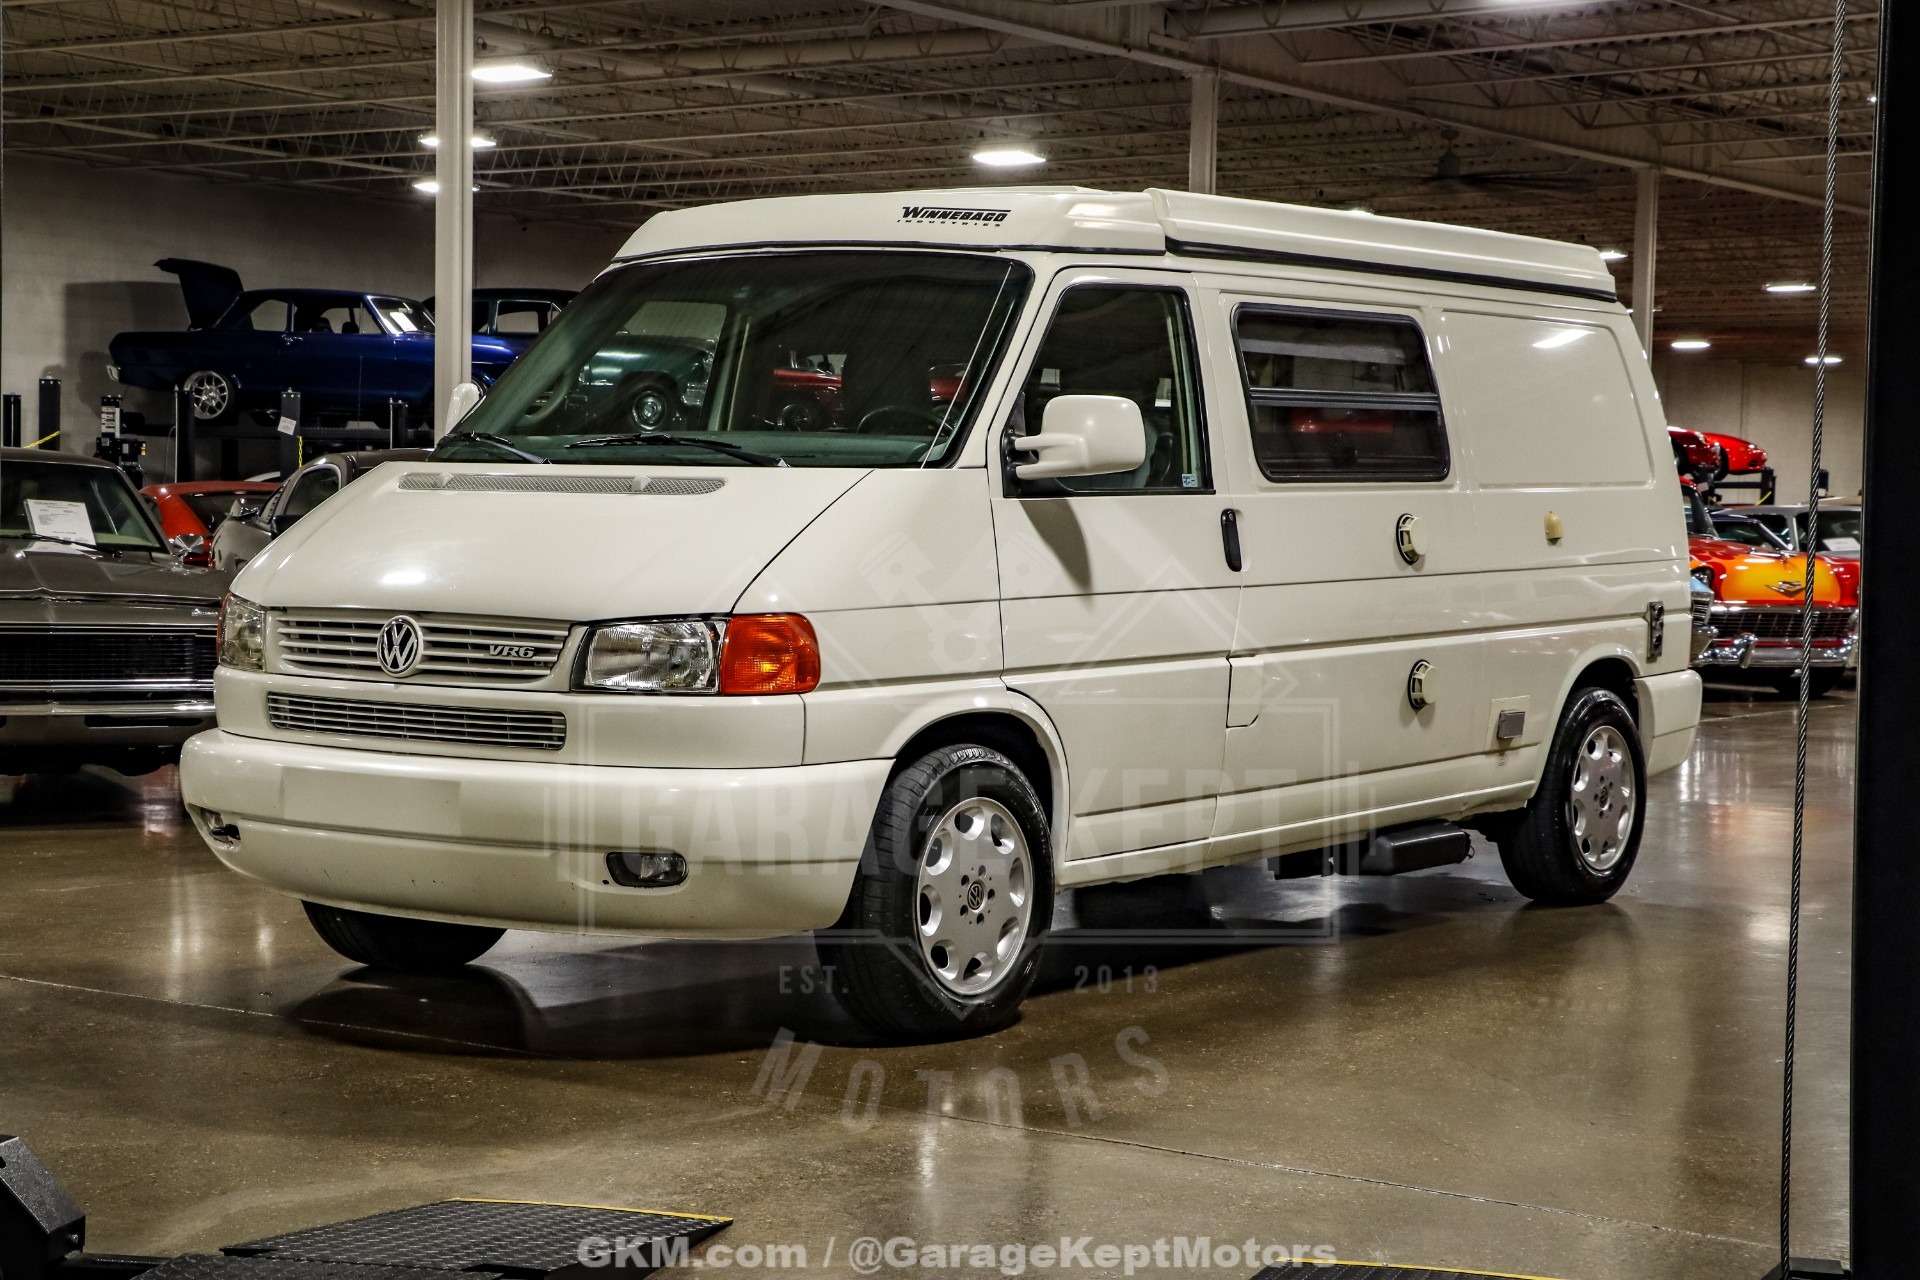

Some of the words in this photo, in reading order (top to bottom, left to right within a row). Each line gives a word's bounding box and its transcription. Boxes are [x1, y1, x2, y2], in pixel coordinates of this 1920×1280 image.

[902, 206, 1011, 222] WINNEBAGO
[897, 219, 1001, 227] INDUSTRIES
[489, 644, 535, 658] VR6
